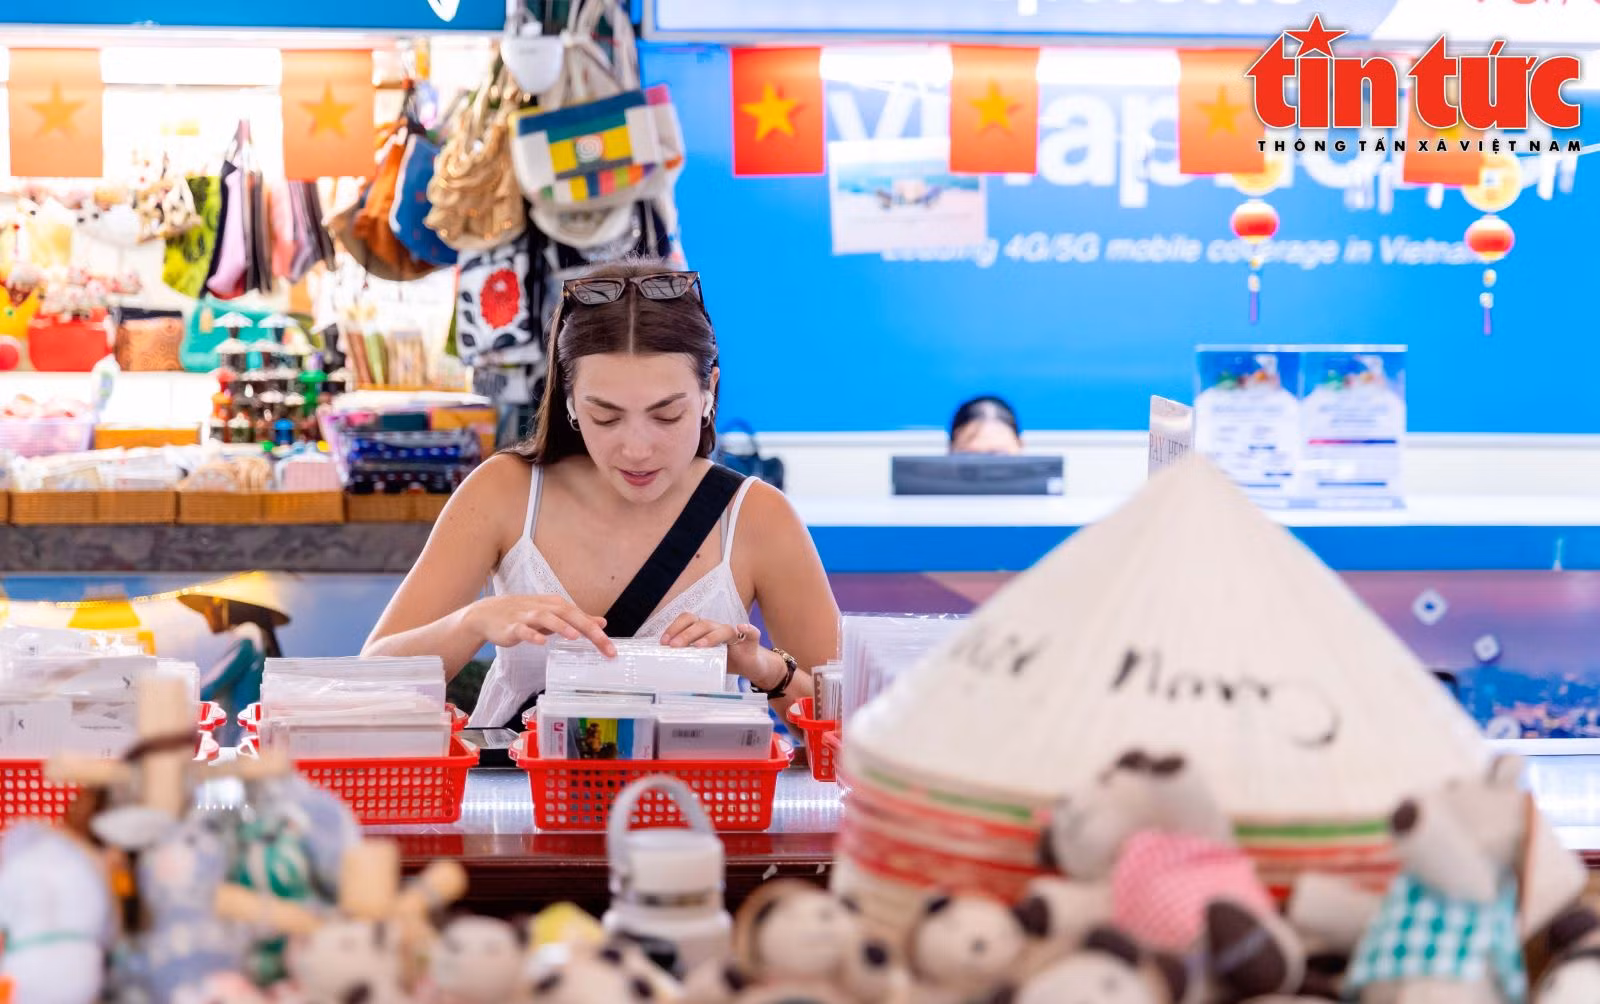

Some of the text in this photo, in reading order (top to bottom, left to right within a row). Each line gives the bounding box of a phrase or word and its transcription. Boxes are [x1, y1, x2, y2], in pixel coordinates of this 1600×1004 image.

[1104, 236, 1201, 263] mobile
[1206, 237, 1339, 269] coverage
[1345, 235, 1372, 263] in
